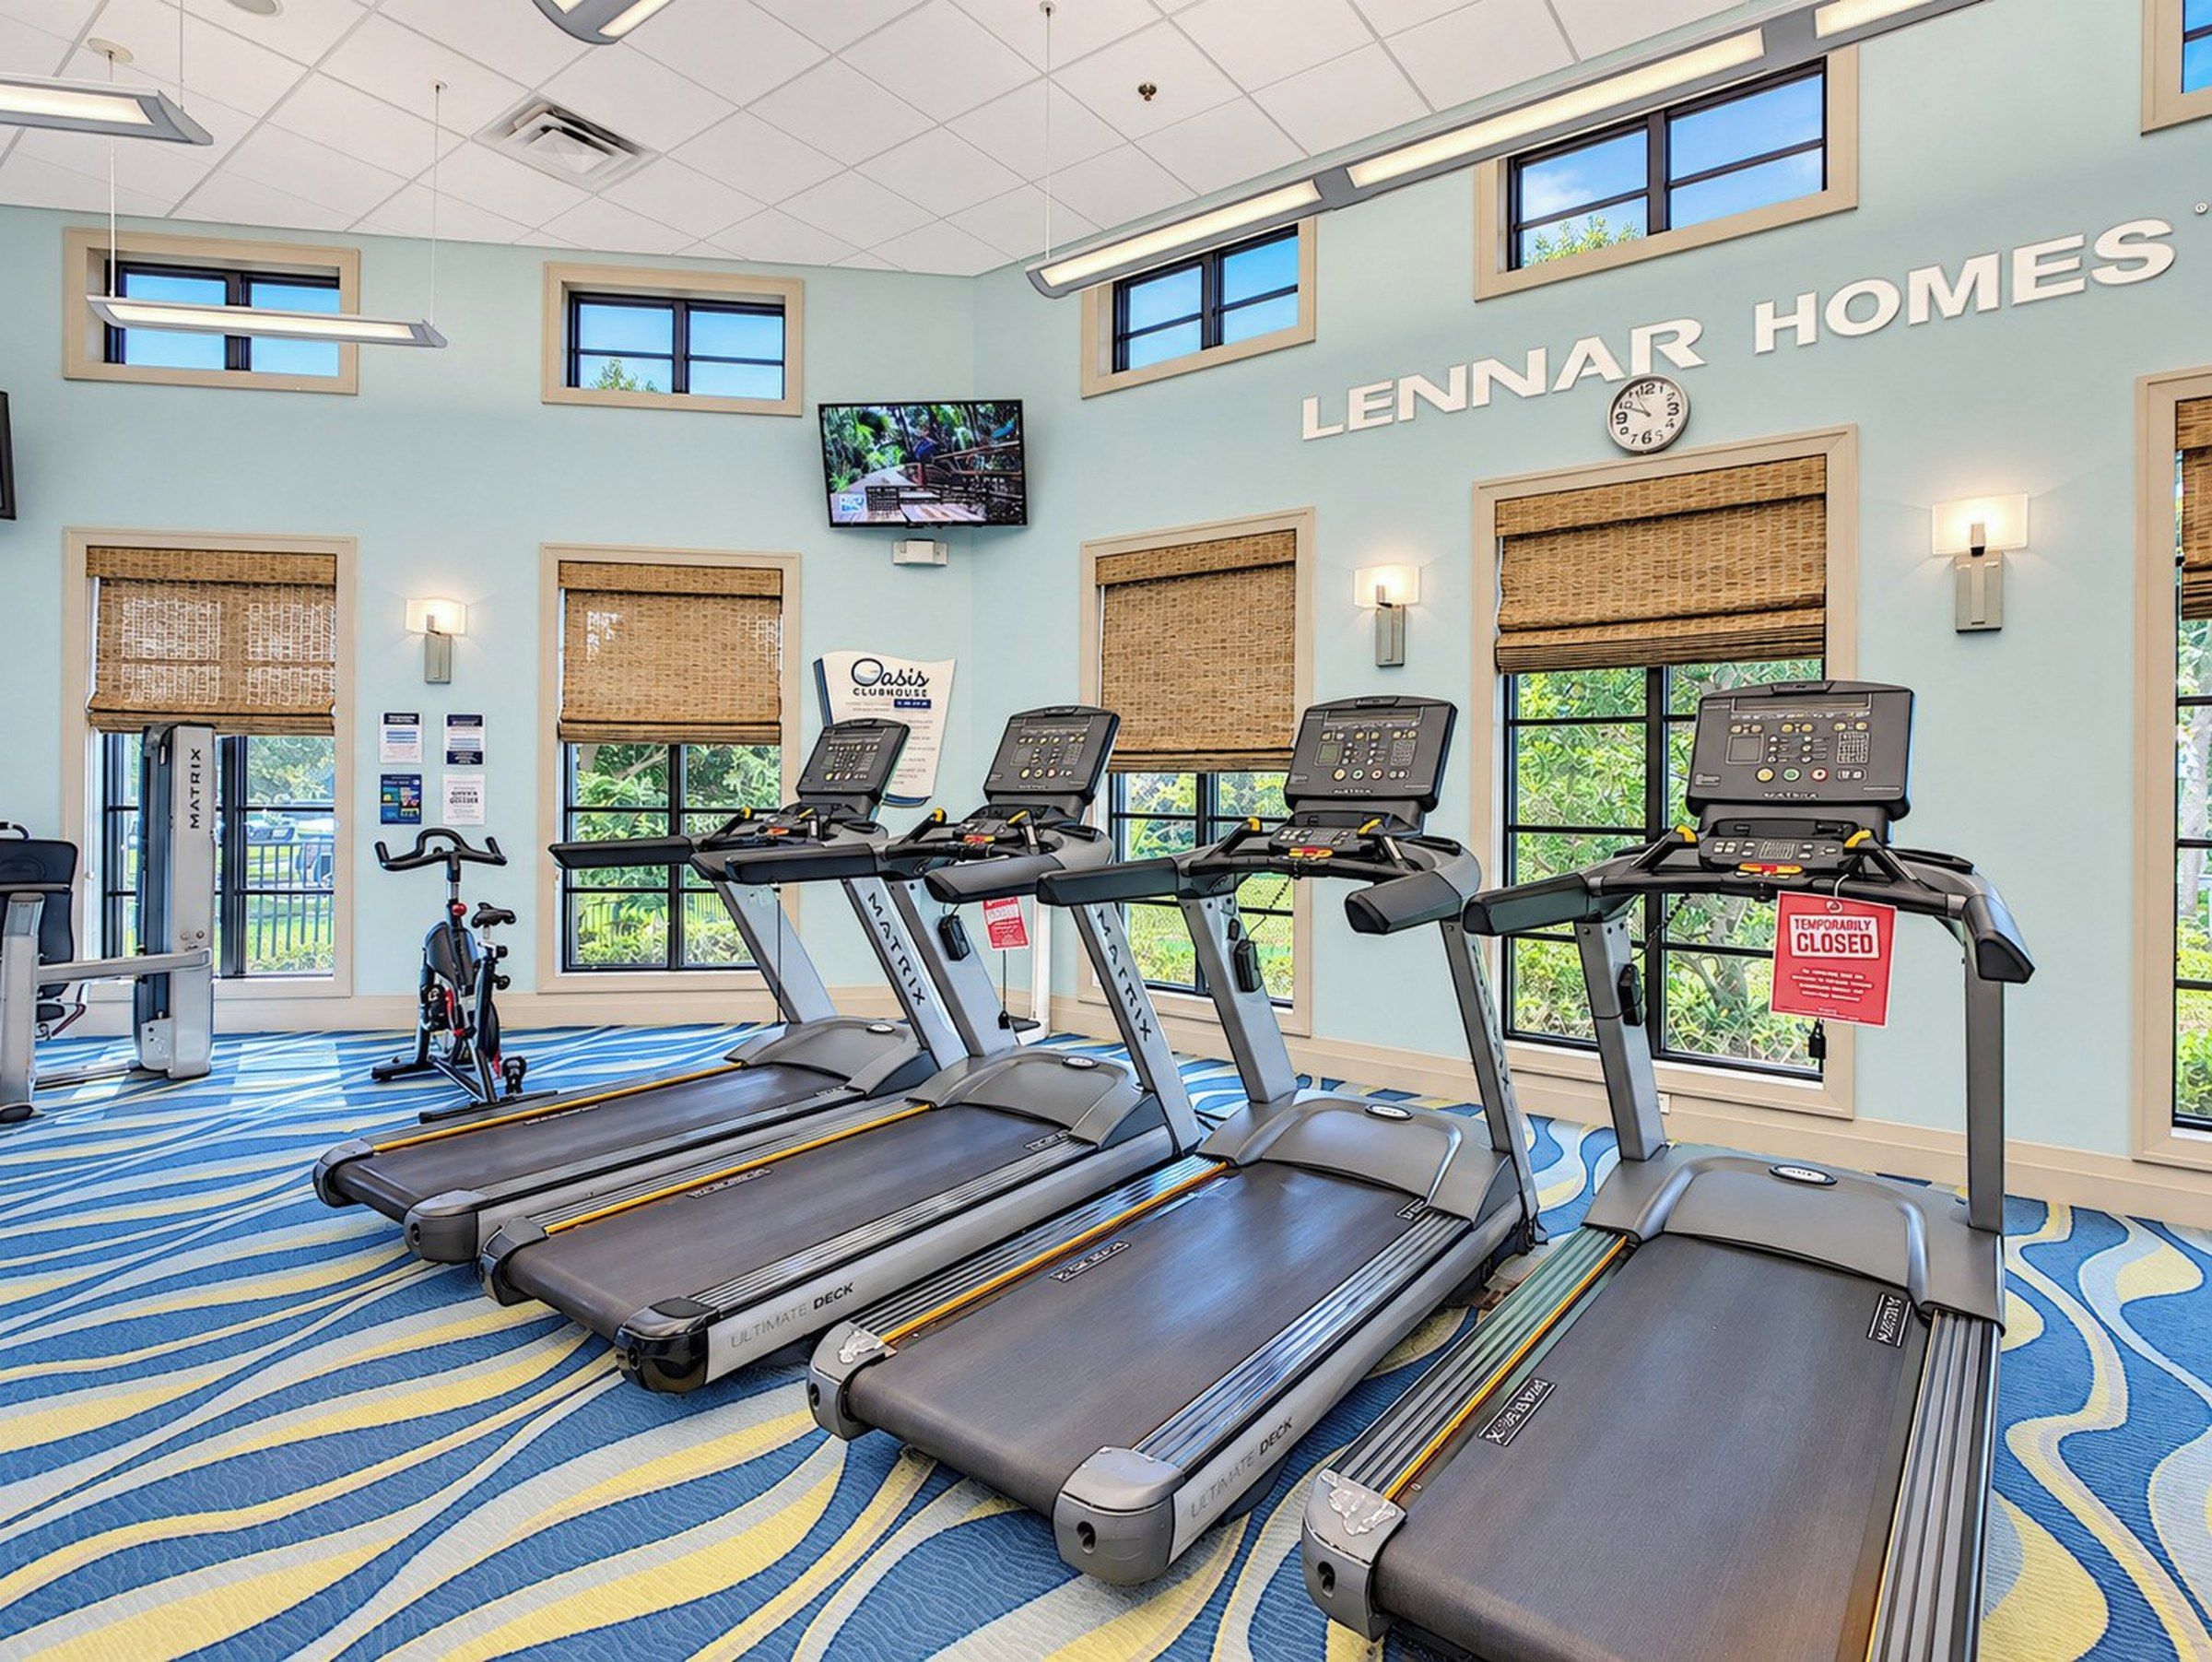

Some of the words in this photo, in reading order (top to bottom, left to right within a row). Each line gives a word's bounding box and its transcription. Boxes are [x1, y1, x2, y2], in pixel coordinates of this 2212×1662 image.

[1301, 318, 1708, 442] LENNAR
[1754, 218, 2176, 355] HOMES
[1639, 383, 1656, 395] 12
[1615, 411, 1629, 425] 9
[1666, 401, 1680, 417] 3
[1641, 429, 1653, 444] 6
[851, 658, 930, 688] Oasis
[853, 687, 928, 698] CLUBHOUSE
[190, 748, 202, 830] MATRIX
[868, 891, 925, 1006] MATRIX
[1796, 932, 1874, 954] CLOSED
[731, 1302, 807, 1348] ULTIMATE
[813, 1282, 854, 1311] DECK
